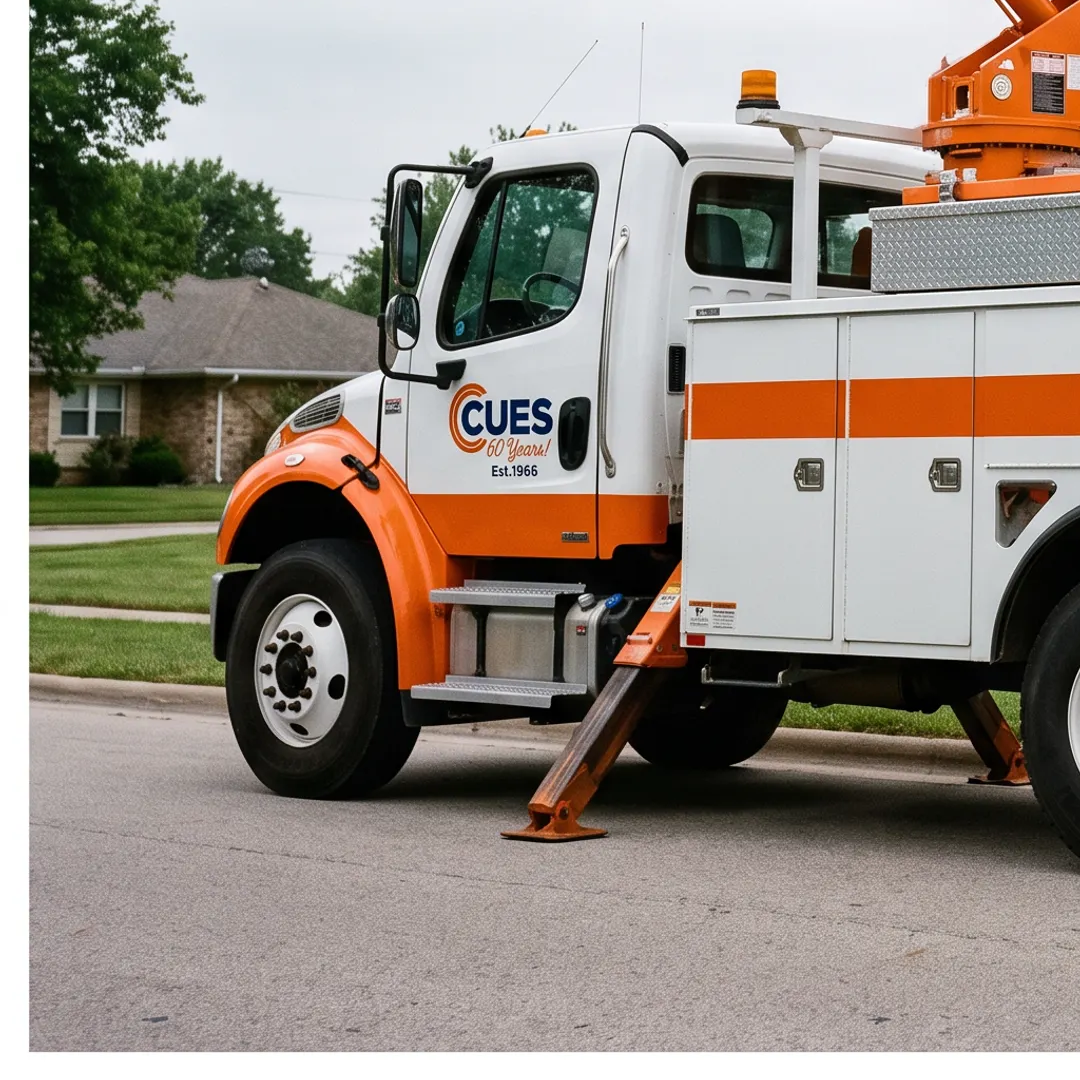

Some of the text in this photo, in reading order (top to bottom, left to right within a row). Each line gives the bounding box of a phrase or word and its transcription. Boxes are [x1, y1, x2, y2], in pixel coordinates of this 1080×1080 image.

[461, 398, 553, 436] CUES
[486, 437, 552, 463] 60 Years!
[491, 464, 538, 477] Est.1966
